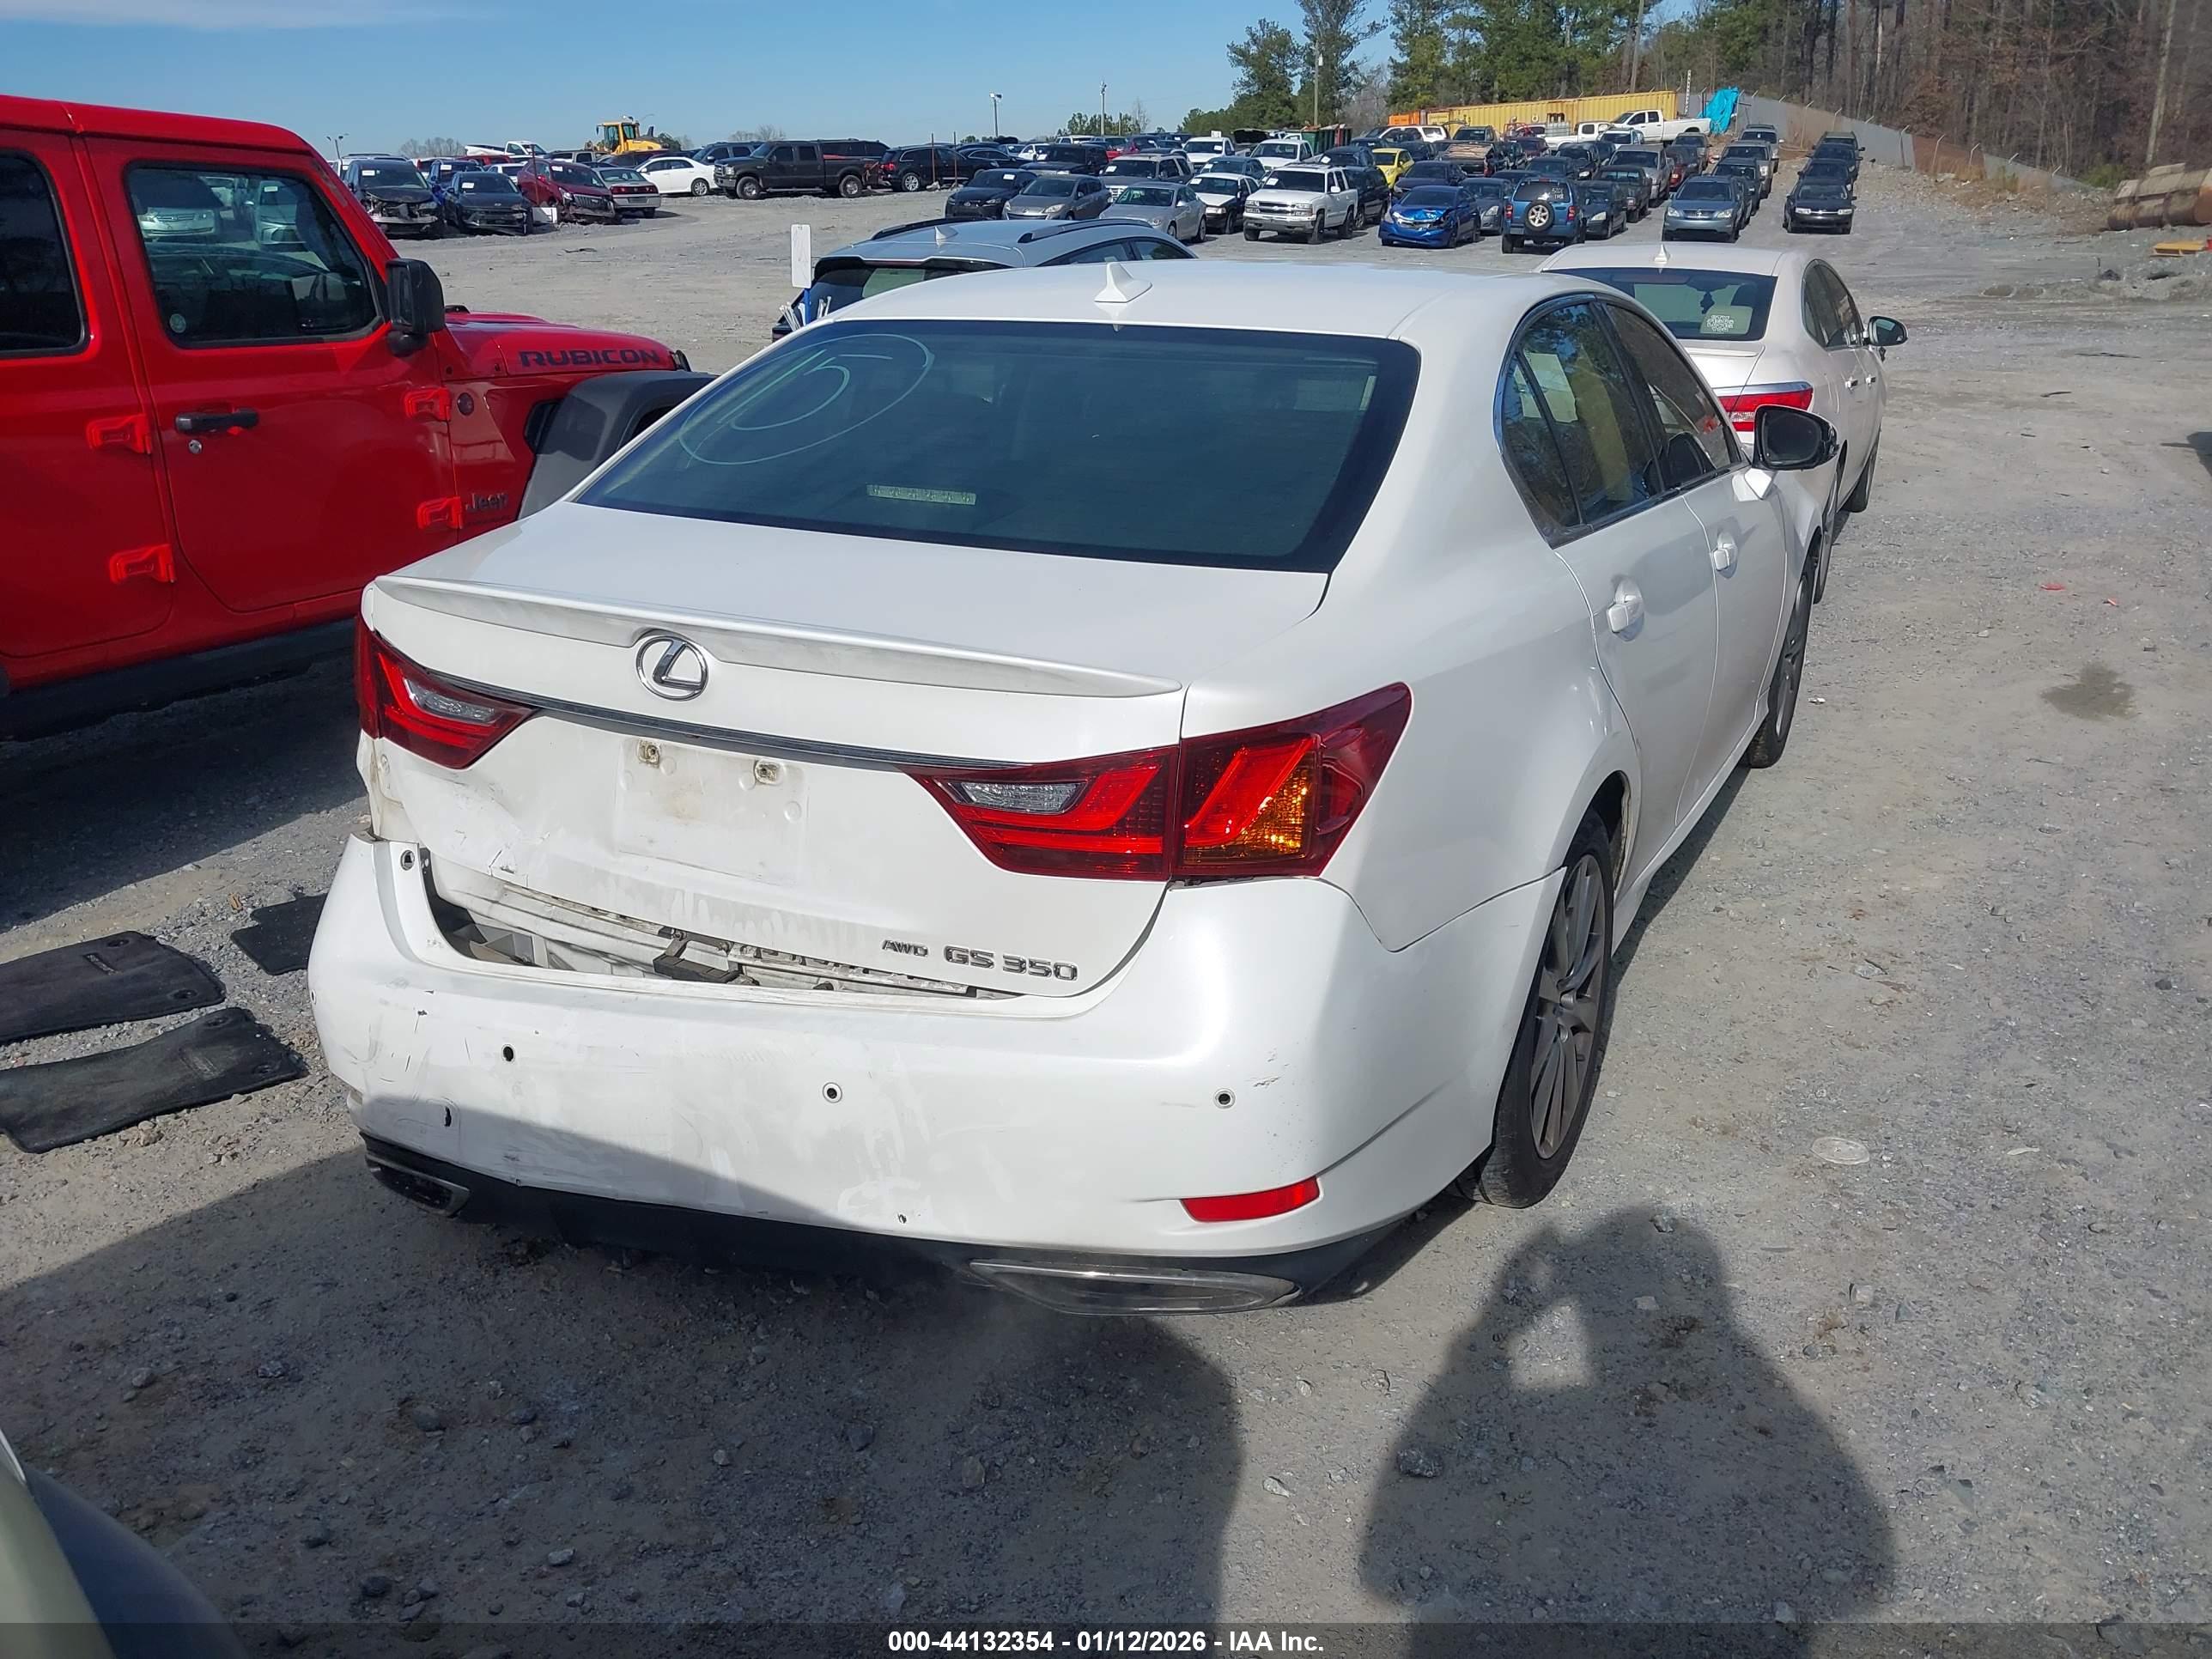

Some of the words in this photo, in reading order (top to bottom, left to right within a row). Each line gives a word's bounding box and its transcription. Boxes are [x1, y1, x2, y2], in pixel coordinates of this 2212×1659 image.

[518, 349, 660, 368] RUBICON
[882, 939, 929, 957] AWD
[943, 945, 995, 969] GS
[1002, 952, 1079, 981] 350
